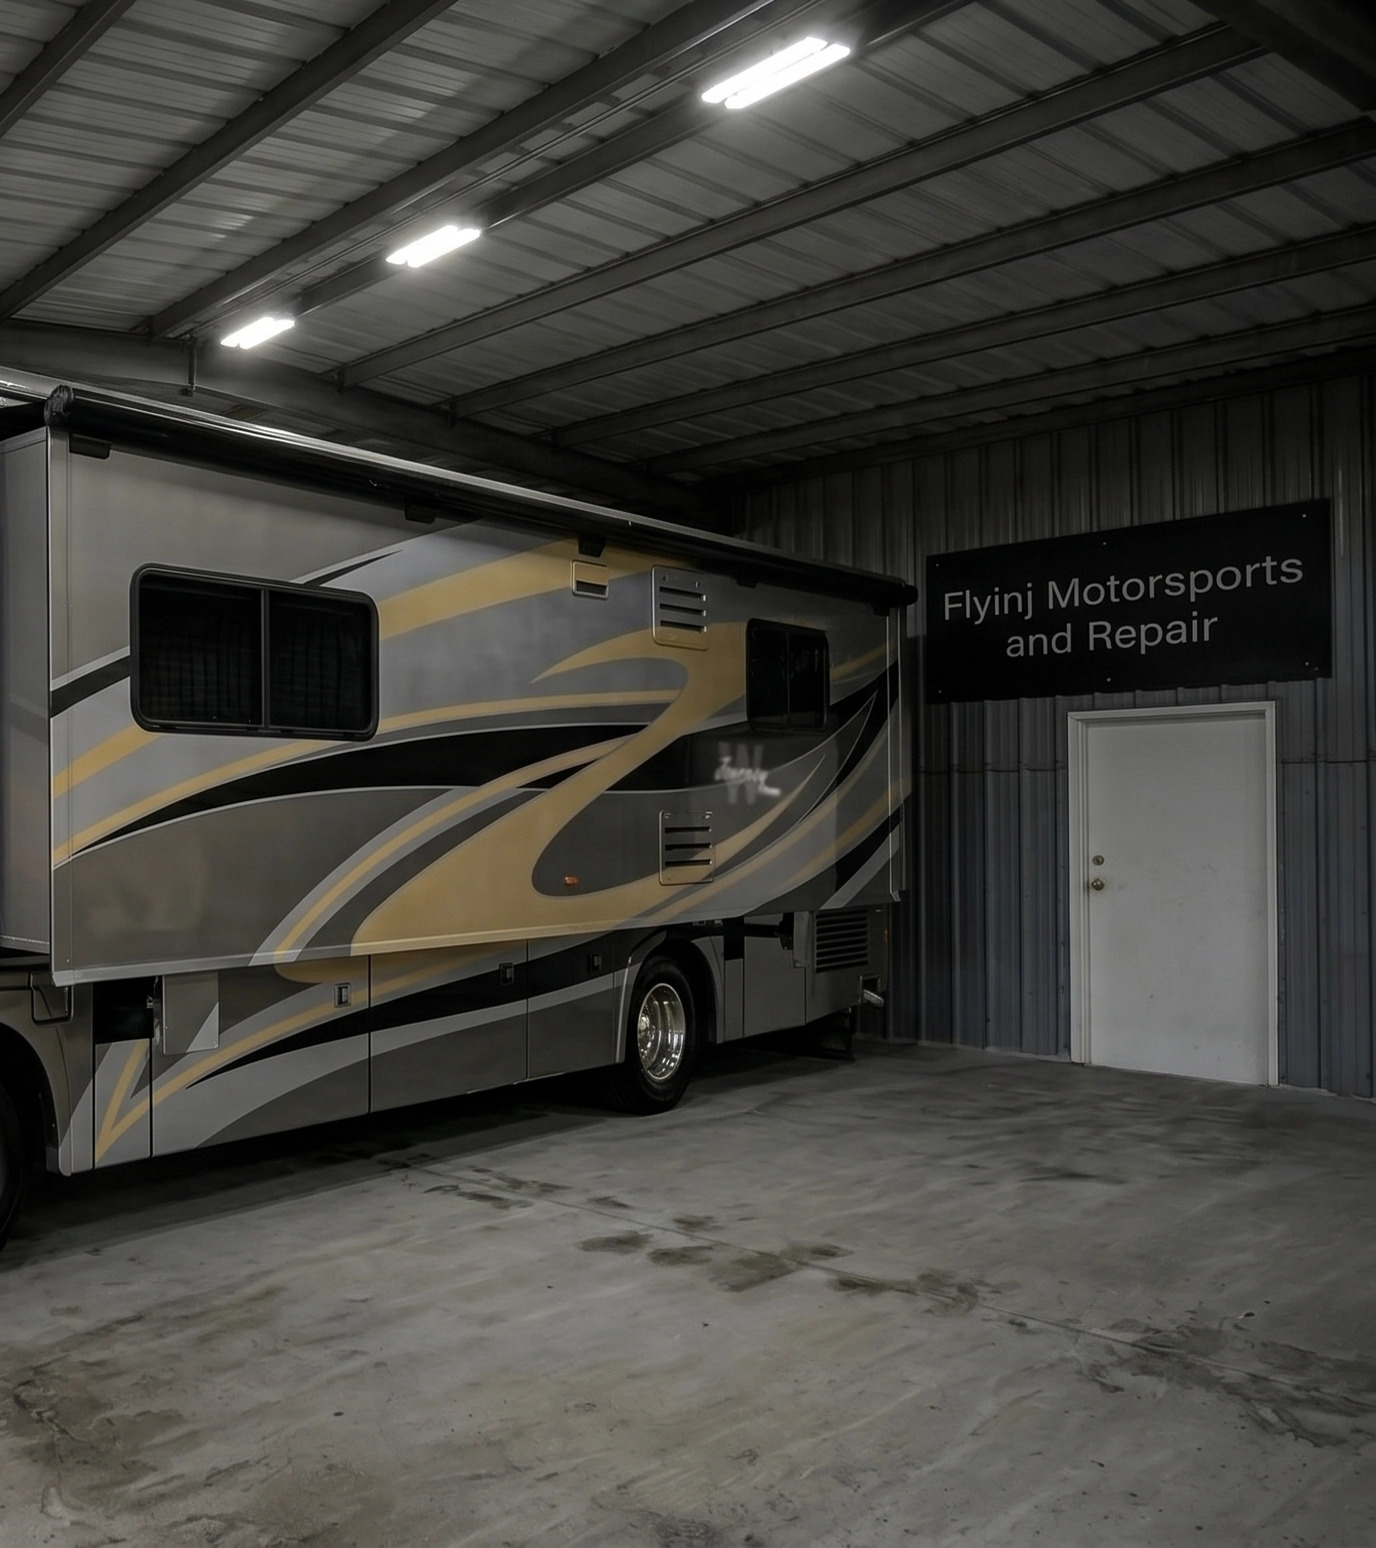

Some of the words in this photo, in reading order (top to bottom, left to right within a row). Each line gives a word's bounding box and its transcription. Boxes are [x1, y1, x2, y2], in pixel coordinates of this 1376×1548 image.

[943, 582, 1034, 625] Flyinj
[1047, 555, 1304, 610] Motorsports
[1006, 623, 1072, 658] and
[1088, 611, 1218, 655] Repair
